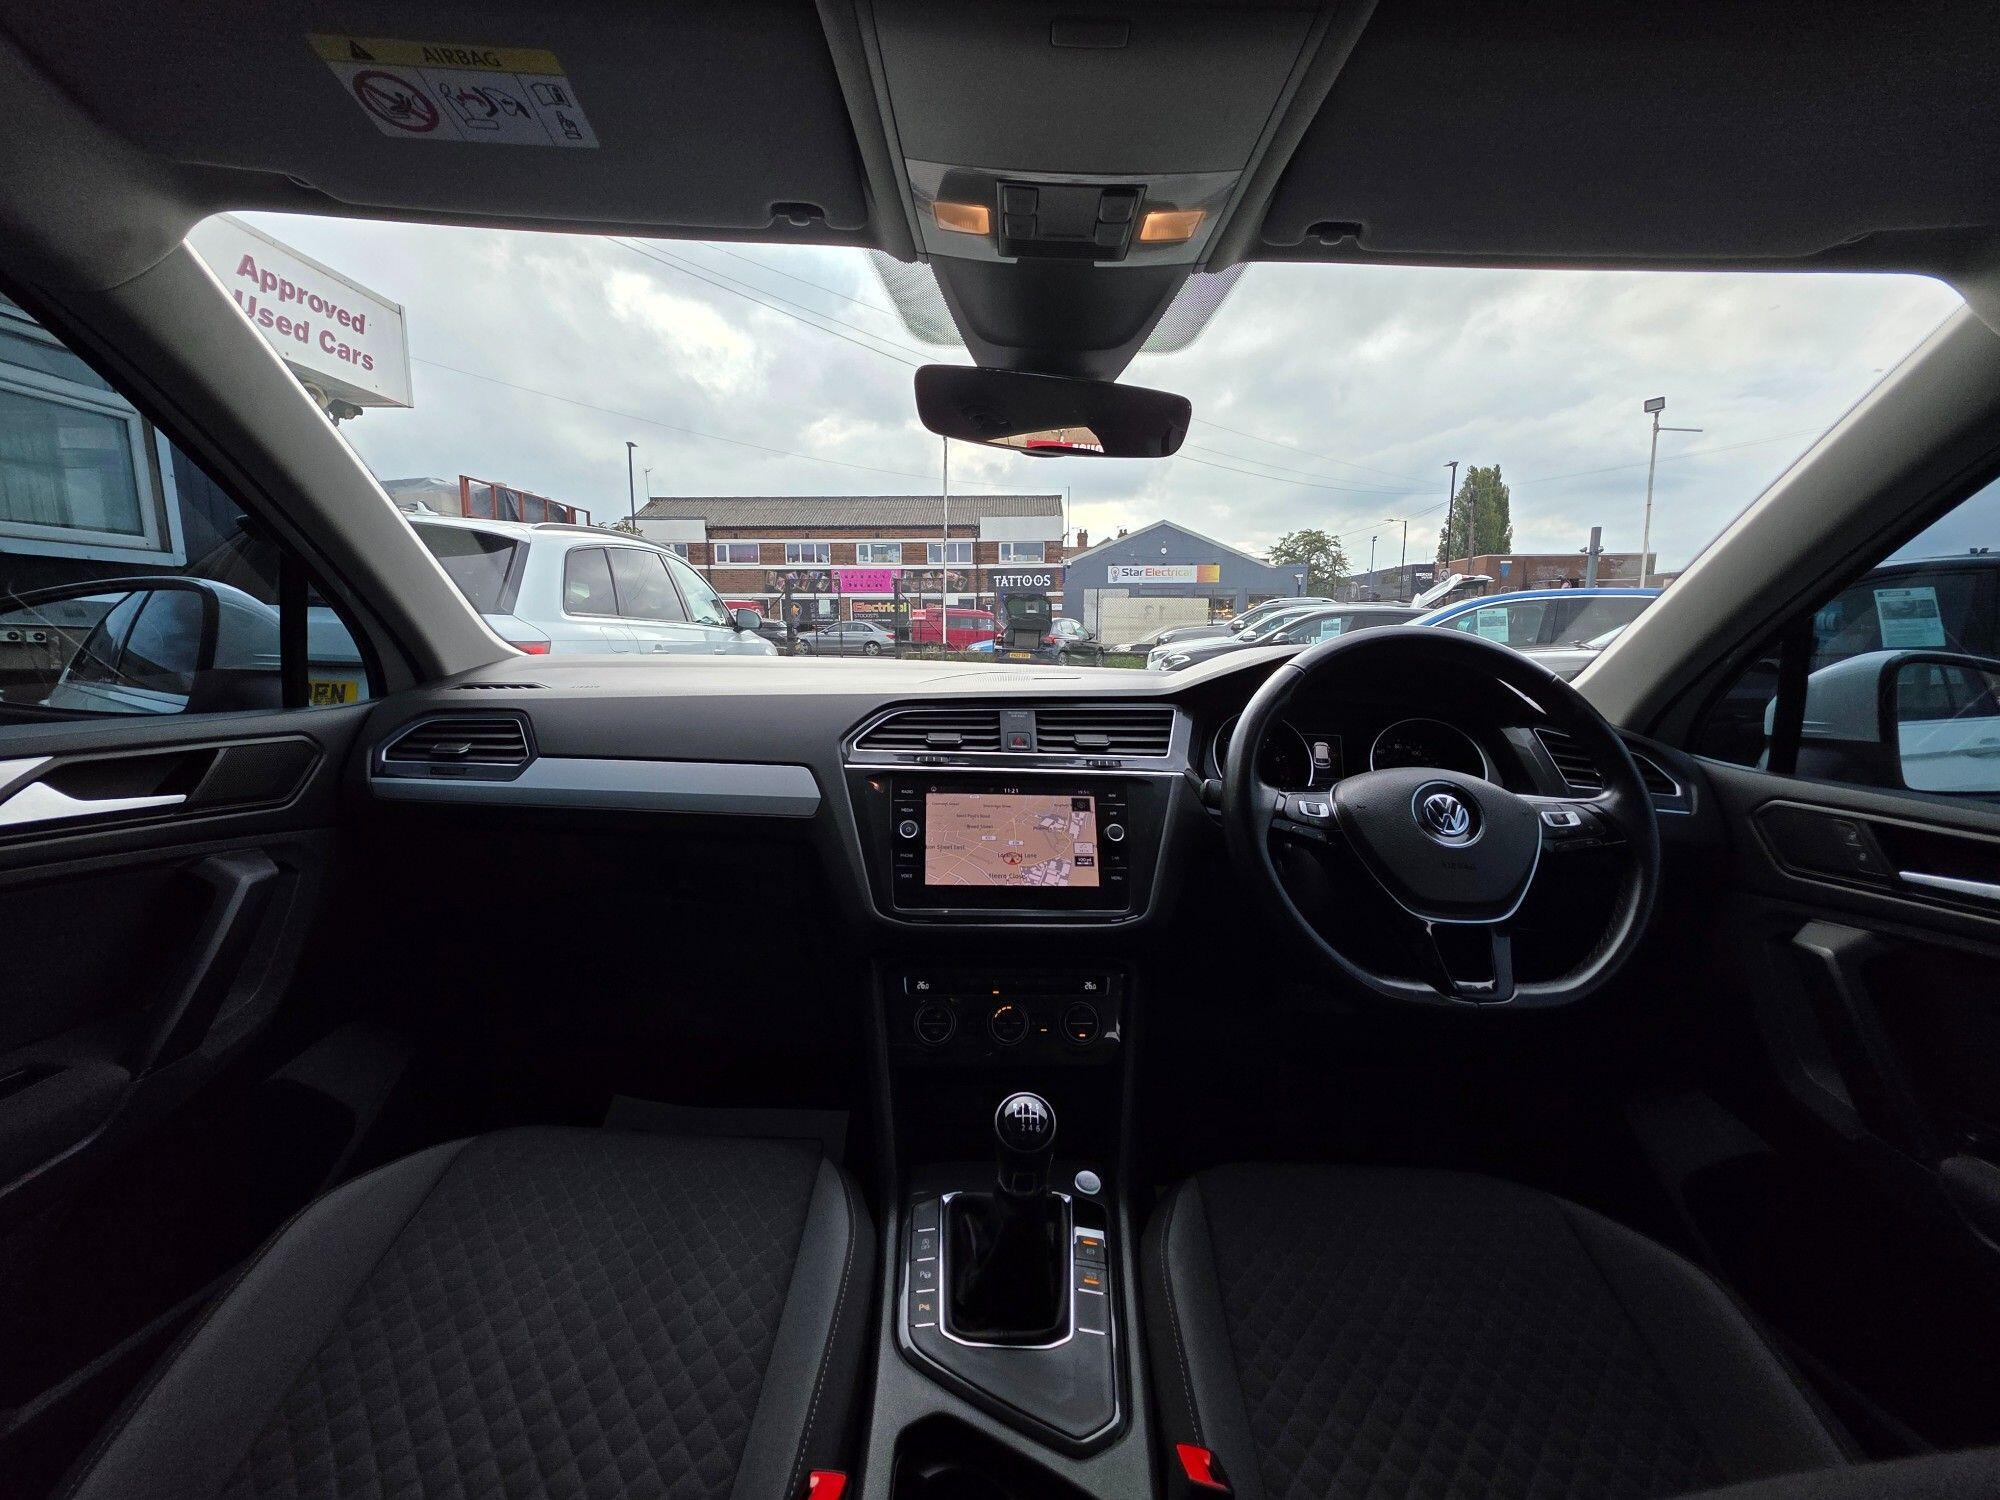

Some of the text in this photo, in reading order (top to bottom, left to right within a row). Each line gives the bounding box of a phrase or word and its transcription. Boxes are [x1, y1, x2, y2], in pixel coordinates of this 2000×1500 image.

[422, 48, 501, 68] AIRBAG
[236, 254, 366, 335] Approved
[234, 289, 374, 371] Used Cars
[993, 575, 1051, 587] TATTOOS
[1121, 567, 1192, 577] Star Electrical
